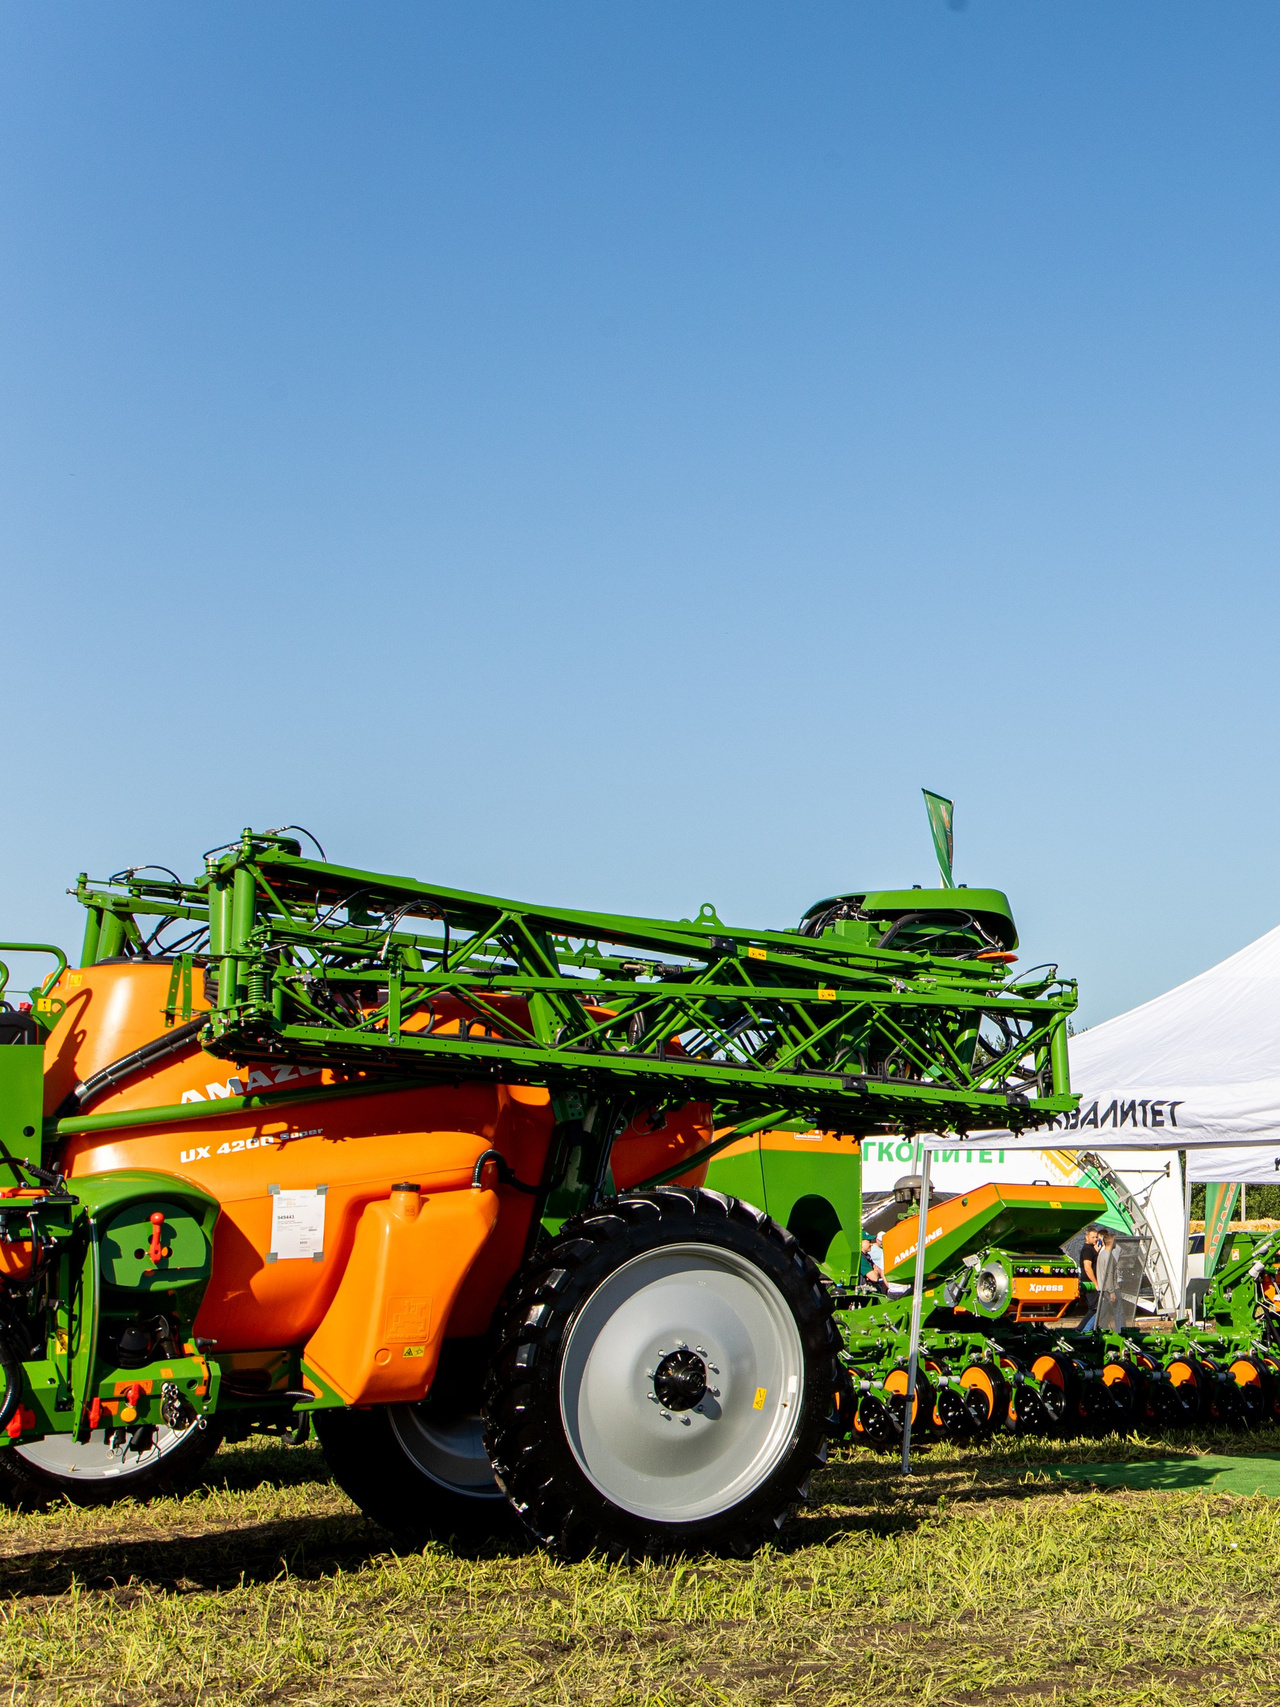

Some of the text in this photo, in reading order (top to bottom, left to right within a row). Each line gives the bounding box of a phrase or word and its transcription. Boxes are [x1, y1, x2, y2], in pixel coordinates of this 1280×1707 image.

[180, 1128, 324, 1163] UX 4200 Super
[894, 1226, 943, 1265] AMANE
[1029, 1283, 1064, 1293] Xpress
